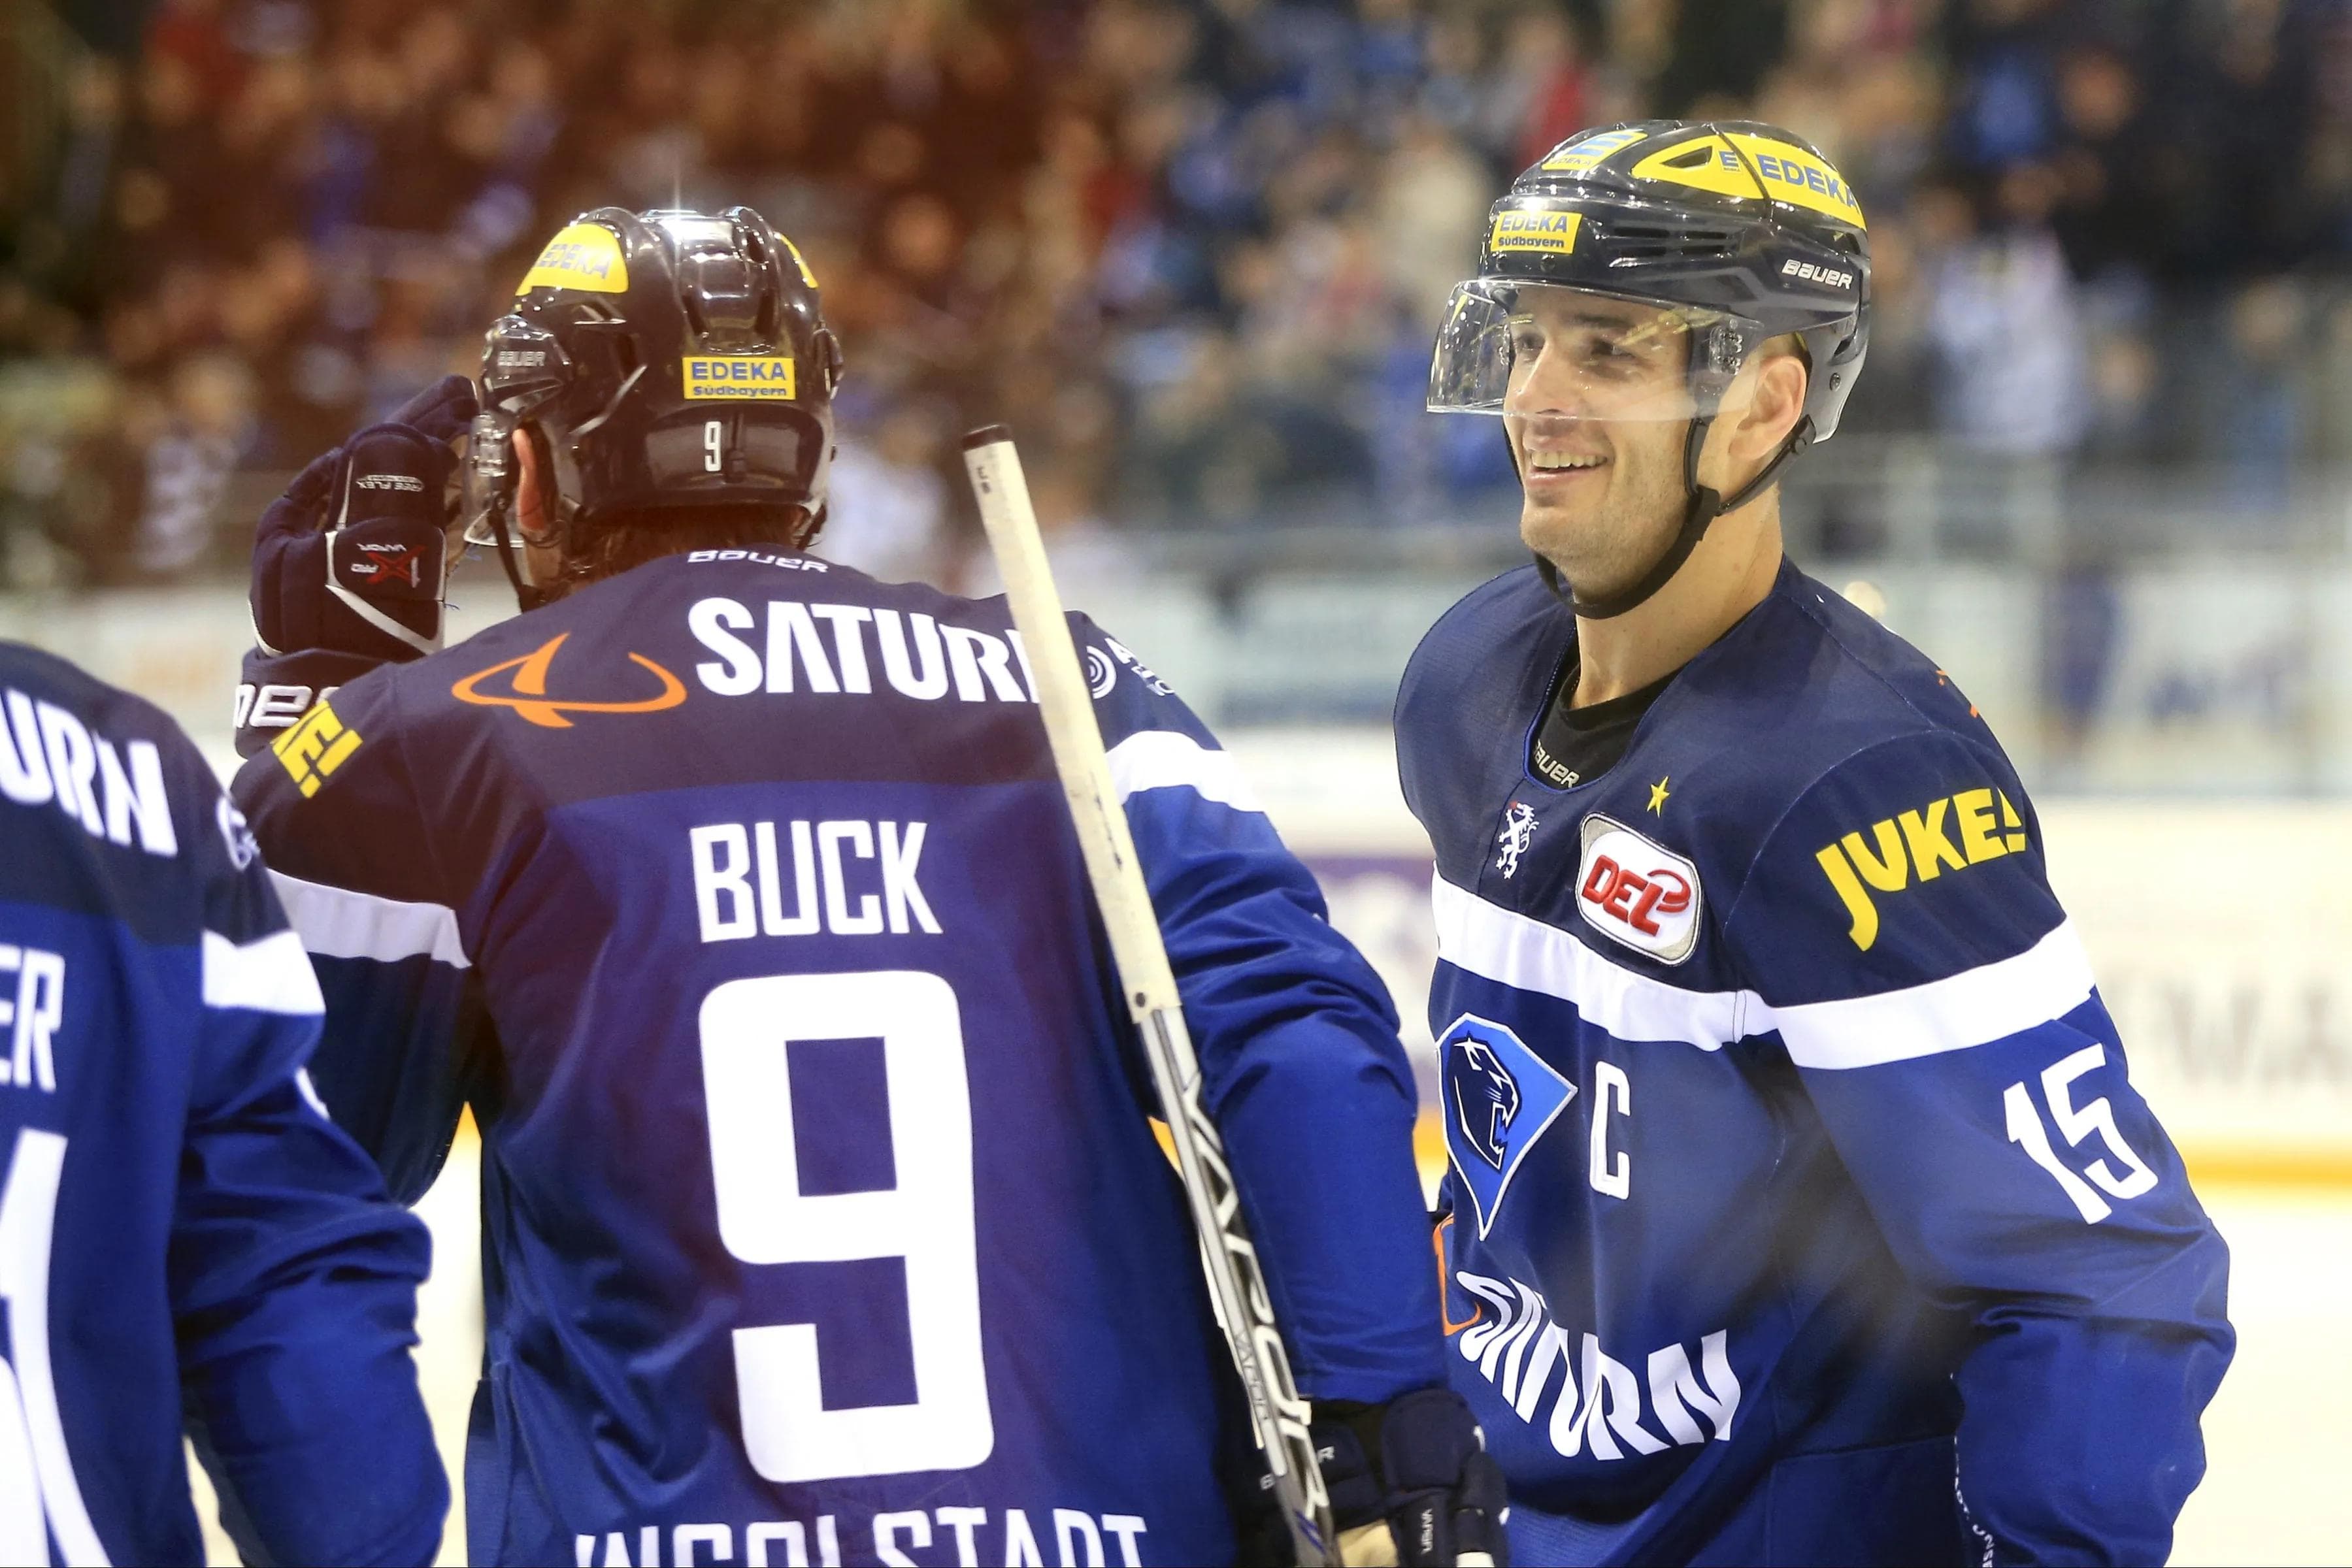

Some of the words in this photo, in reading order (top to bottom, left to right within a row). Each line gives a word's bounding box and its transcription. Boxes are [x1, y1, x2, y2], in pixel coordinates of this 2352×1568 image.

[1756, 154, 1856, 208] EDEKA
[1497, 237, 1565, 248] Südbayern
[1499, 214, 1568, 233] EDEKA
[535, 244, 612, 279] EDEKA
[1781, 259, 1853, 290] BAUER
[691, 361, 787, 381] EDEKA
[693, 385, 787, 397] Südbayern
[704, 421, 721, 472] 9
[687, 550, 829, 572] BAUER
[690, 821, 943, 943] BUCK
[1582, 855, 1663, 936] DEL
[1816, 788, 2026, 951] JUKE!
[1589, 1061, 1631, 1201] C
[2004, 1043, 2158, 1224] 15
[699, 971, 993, 1482] 9
[1181, 1070, 1331, 1520] VAPOR
